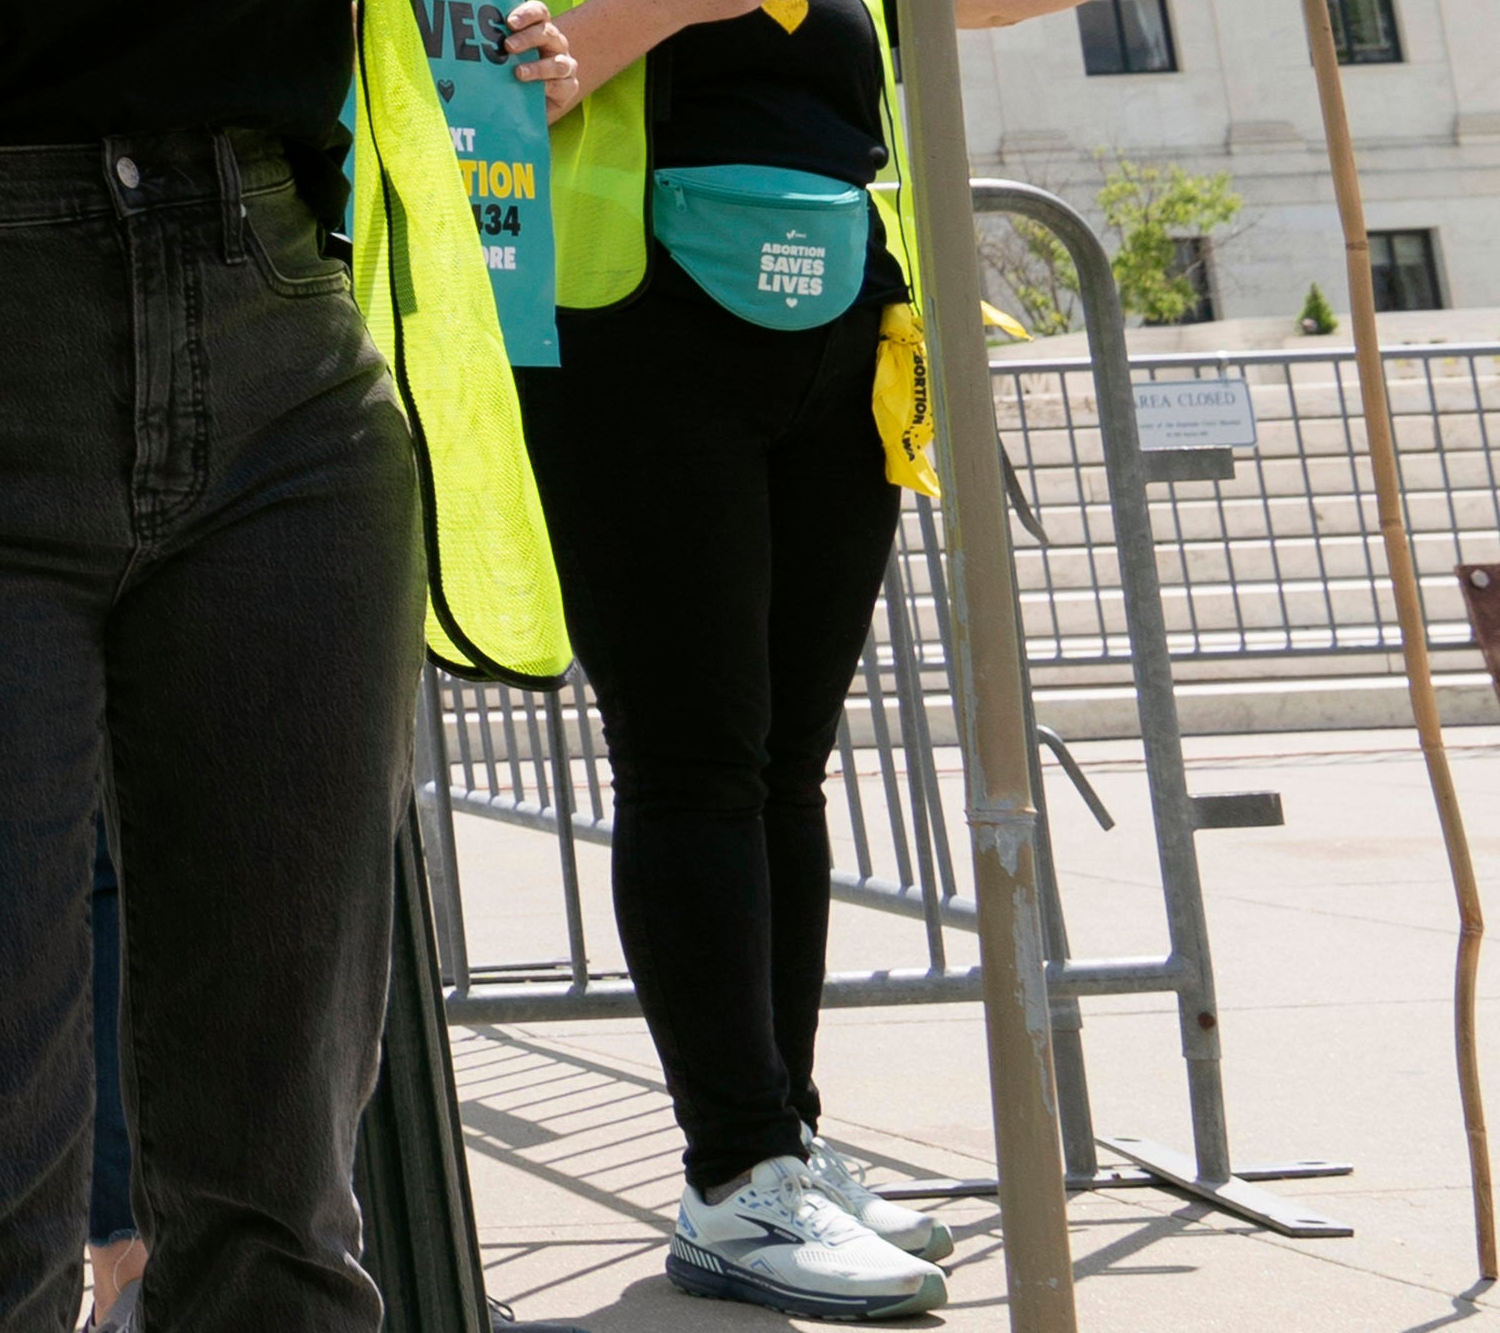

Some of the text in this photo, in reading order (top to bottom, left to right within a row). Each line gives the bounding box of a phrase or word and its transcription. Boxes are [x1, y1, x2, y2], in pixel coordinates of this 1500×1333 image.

[449, 127, 476, 153] XT
[459, 159, 536, 200] TION
[761, 242, 826, 258] ABORTION
[760, 254, 825, 276] SAVES
[757, 272, 823, 296] LIVES
[912, 350, 928, 425] BORTION
[1137, 391, 1237, 409] REA CLOSED
